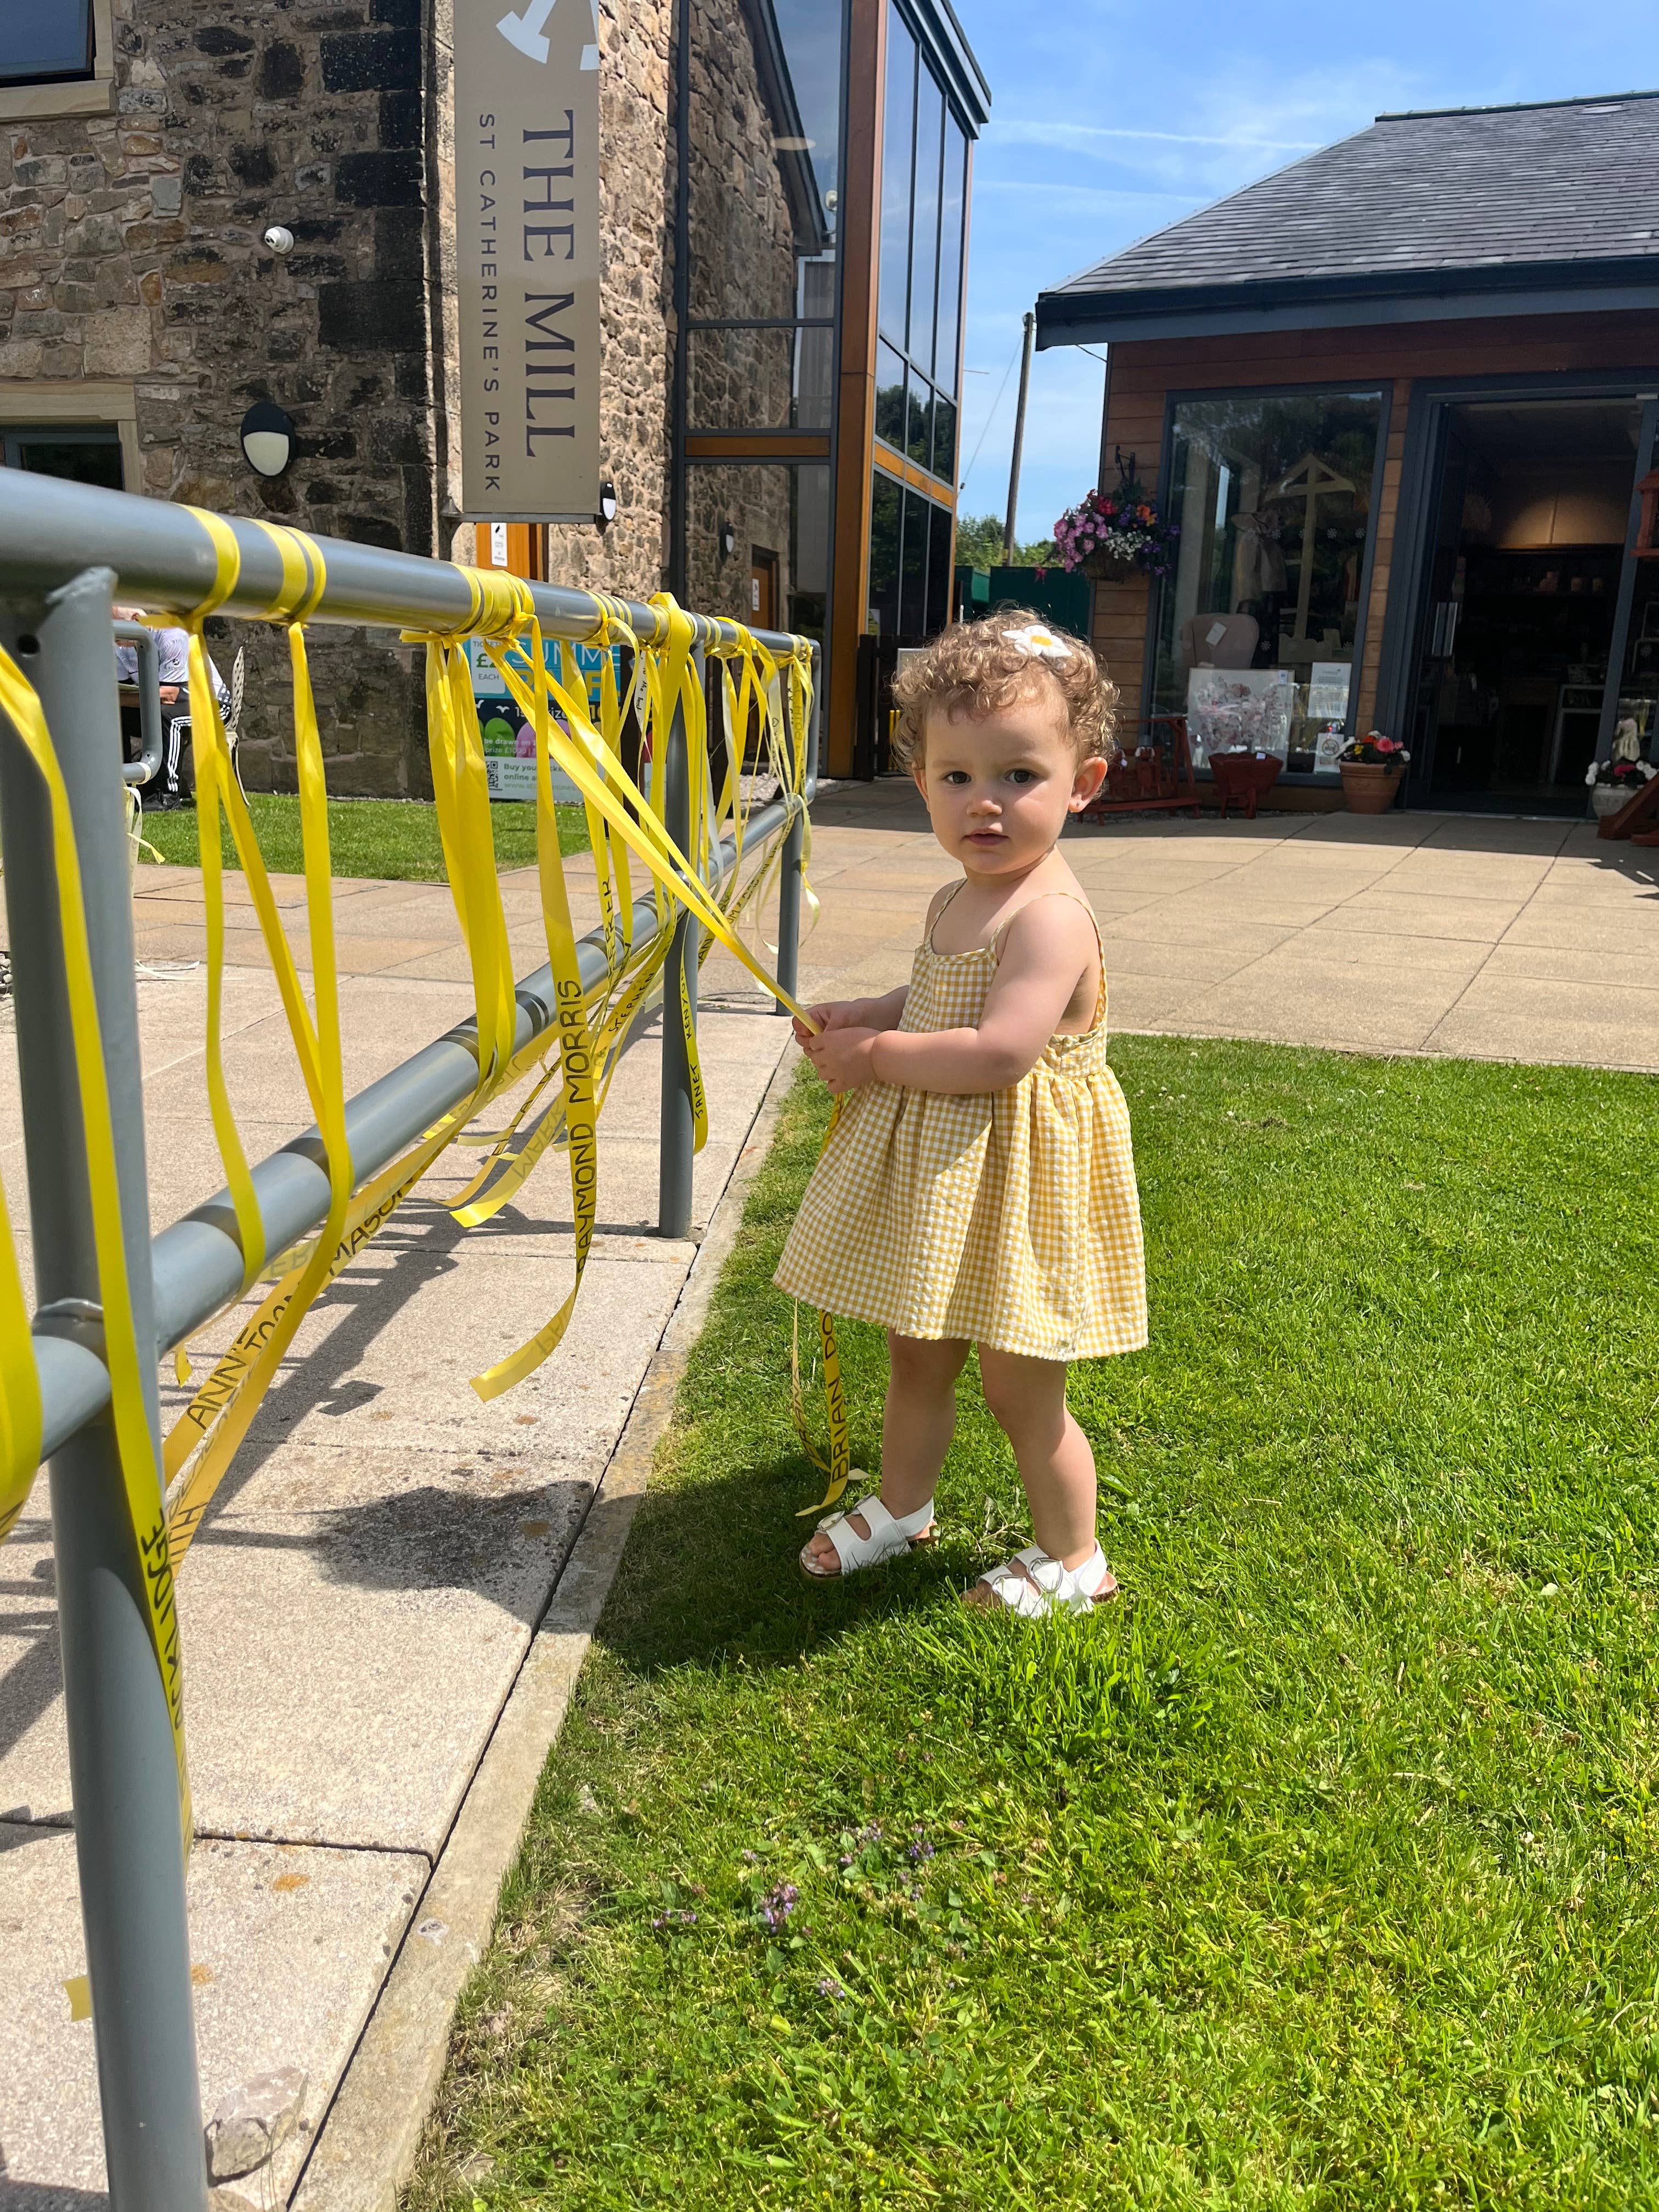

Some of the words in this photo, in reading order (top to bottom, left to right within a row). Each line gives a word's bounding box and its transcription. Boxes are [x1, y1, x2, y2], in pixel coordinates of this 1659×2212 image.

[479, 114, 495, 150] ST
[523, 110, 574, 262] THE
[479, 170, 499, 393] CATHERINE'S
[524, 292, 575, 458] MILL
[484, 411, 500, 490] PARK
[504, 763, 518, 771] Buy
[557, 980, 592, 1103] MORRIS
[608, 972, 655, 1032] STEPHEN
[690, 1063, 703, 1119] JANET
[827, 1375, 850, 1484] BRIAN
